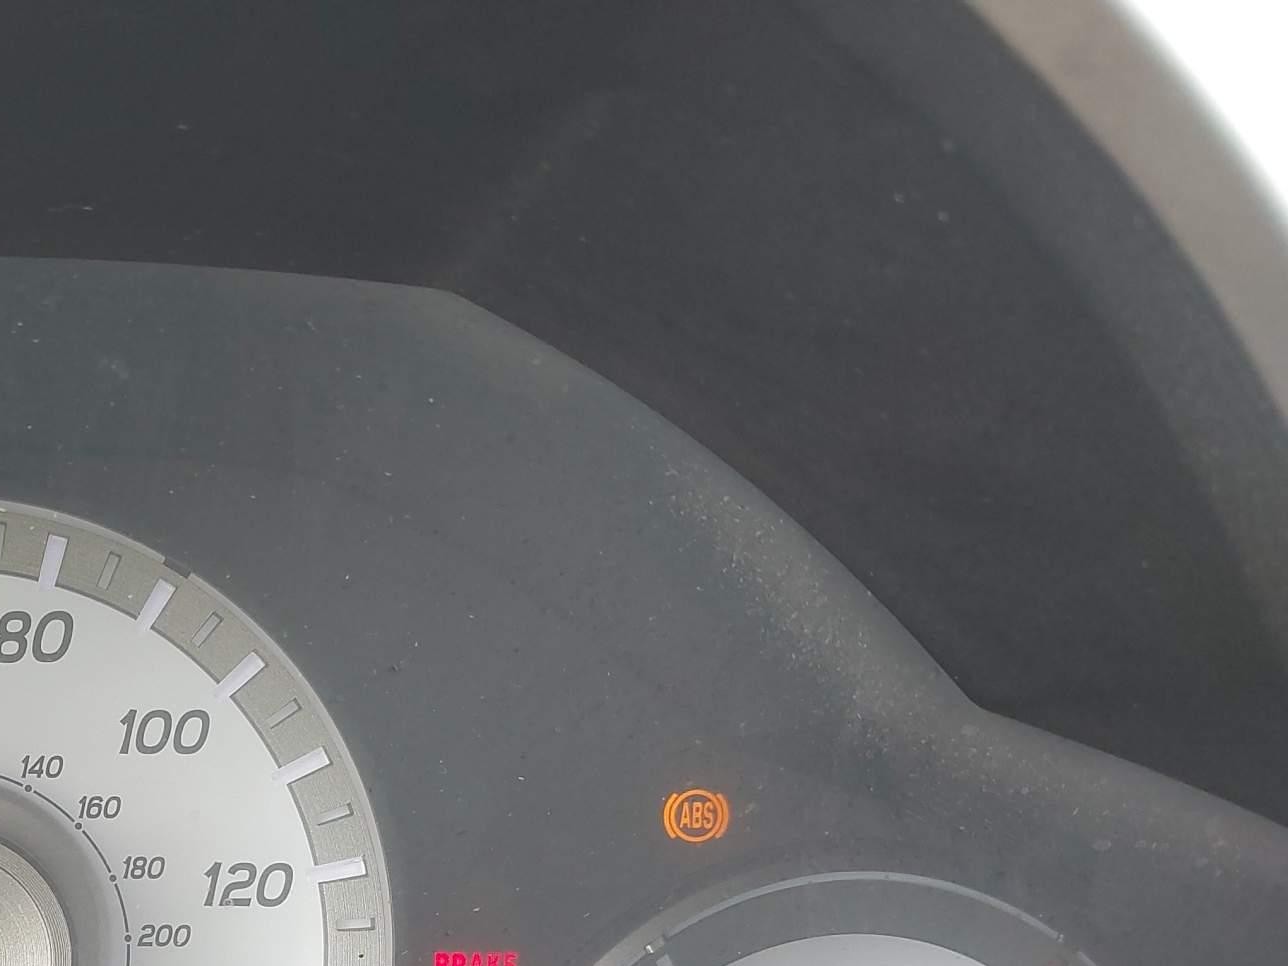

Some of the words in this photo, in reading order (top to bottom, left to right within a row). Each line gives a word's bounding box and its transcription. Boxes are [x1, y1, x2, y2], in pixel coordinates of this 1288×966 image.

[118, 709, 210, 755] 100
[20, 755, 64, 778] 140
[78, 796, 121, 819] 160
[679, 801, 714, 829] ABS
[122, 856, 165, 880] 180
[203, 862, 294, 907] 120
[137, 924, 191, 947] 200
